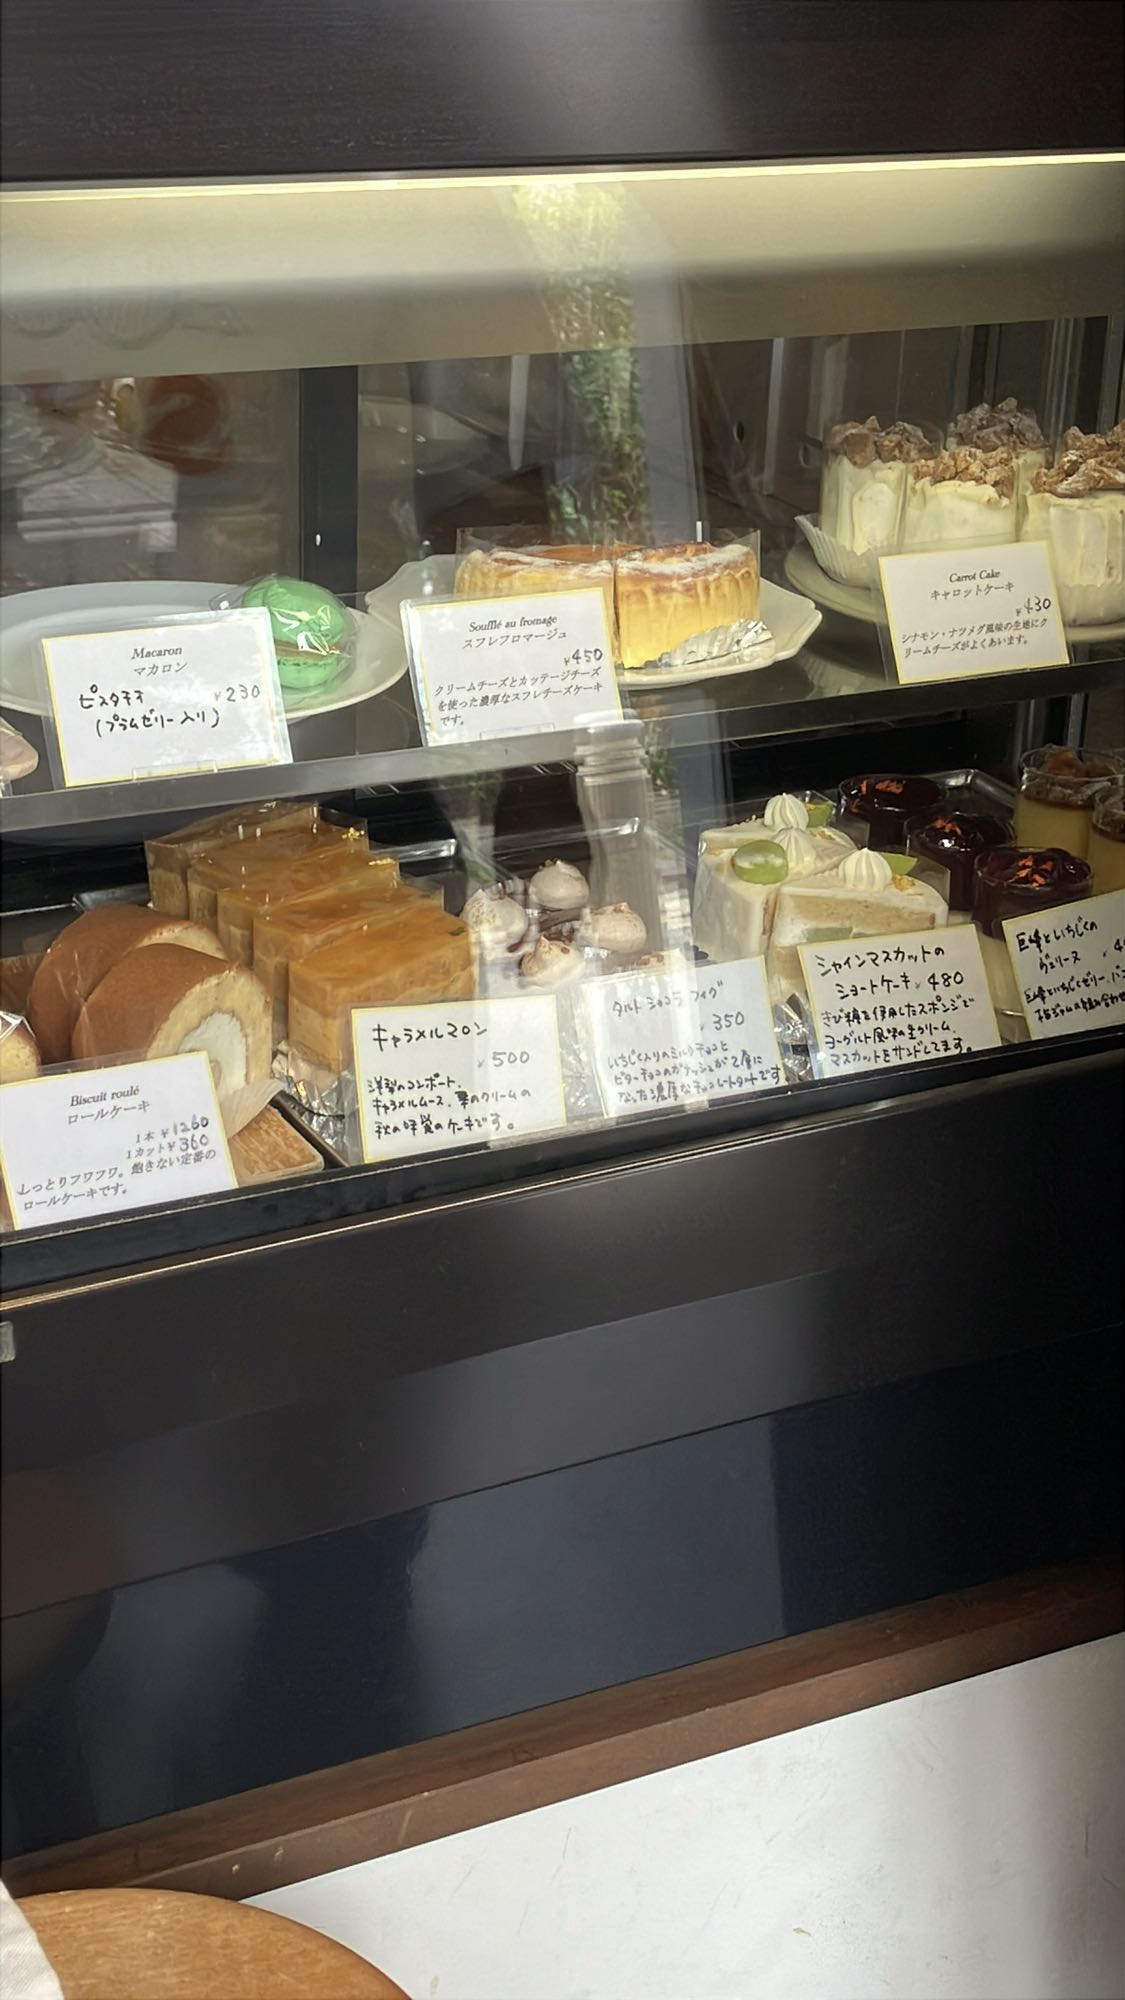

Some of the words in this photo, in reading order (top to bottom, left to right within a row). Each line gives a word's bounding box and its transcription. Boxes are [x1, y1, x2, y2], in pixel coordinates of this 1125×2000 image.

[949, 571, 977, 584] Carrot
[979, 569, 1001, 580] Cake
[930, 581, 1015, 600] キャロットケーキ
[1015, 595, 1052, 616] ¥430
[468, 618, 503, 633] Soufflé
[504, 620, 517, 629] au
[519, 615, 558, 629] fromage
[901, 617, 1048, 644] シナモン・ナツメグ風味の生地にク
[462, 628, 568, 649] スフレフロマージュ
[904, 634, 1028, 658] リームチーズがよくあいます。
[131, 647, 183, 660] Macaron
[564, 647, 604, 666] ¥450
[133, 661, 188, 677] マカロン
[435, 666, 602, 697] クリームチーズとカッテージチーズ
[79, 684, 144, 709] ピスタチオ
[213, 684, 261, 703] ¥230
[438, 681, 604, 711] を使った濃厚なスフレチーズケーキ
[440, 715, 465, 727] です。
[1016, 915, 1098, 953] 巨峰といちじくの
[815, 944, 945, 977] シャインマスカットの
[835, 972, 911, 1000] ショートケーキ
[821, 994, 975, 1027] きび糖を使用したスポンジで
[372, 1021, 488, 1052] キャラメルマロン
[830, 1037, 973, 1067] マスカットをサンドしてます。
[70, 1091, 108, 1107] Biscuit
[110, 1085, 140, 1101] roulé
[67, 1099, 151, 1125] ロールケーキ
[23, 1182, 128, 1211] ロールケーキです。
